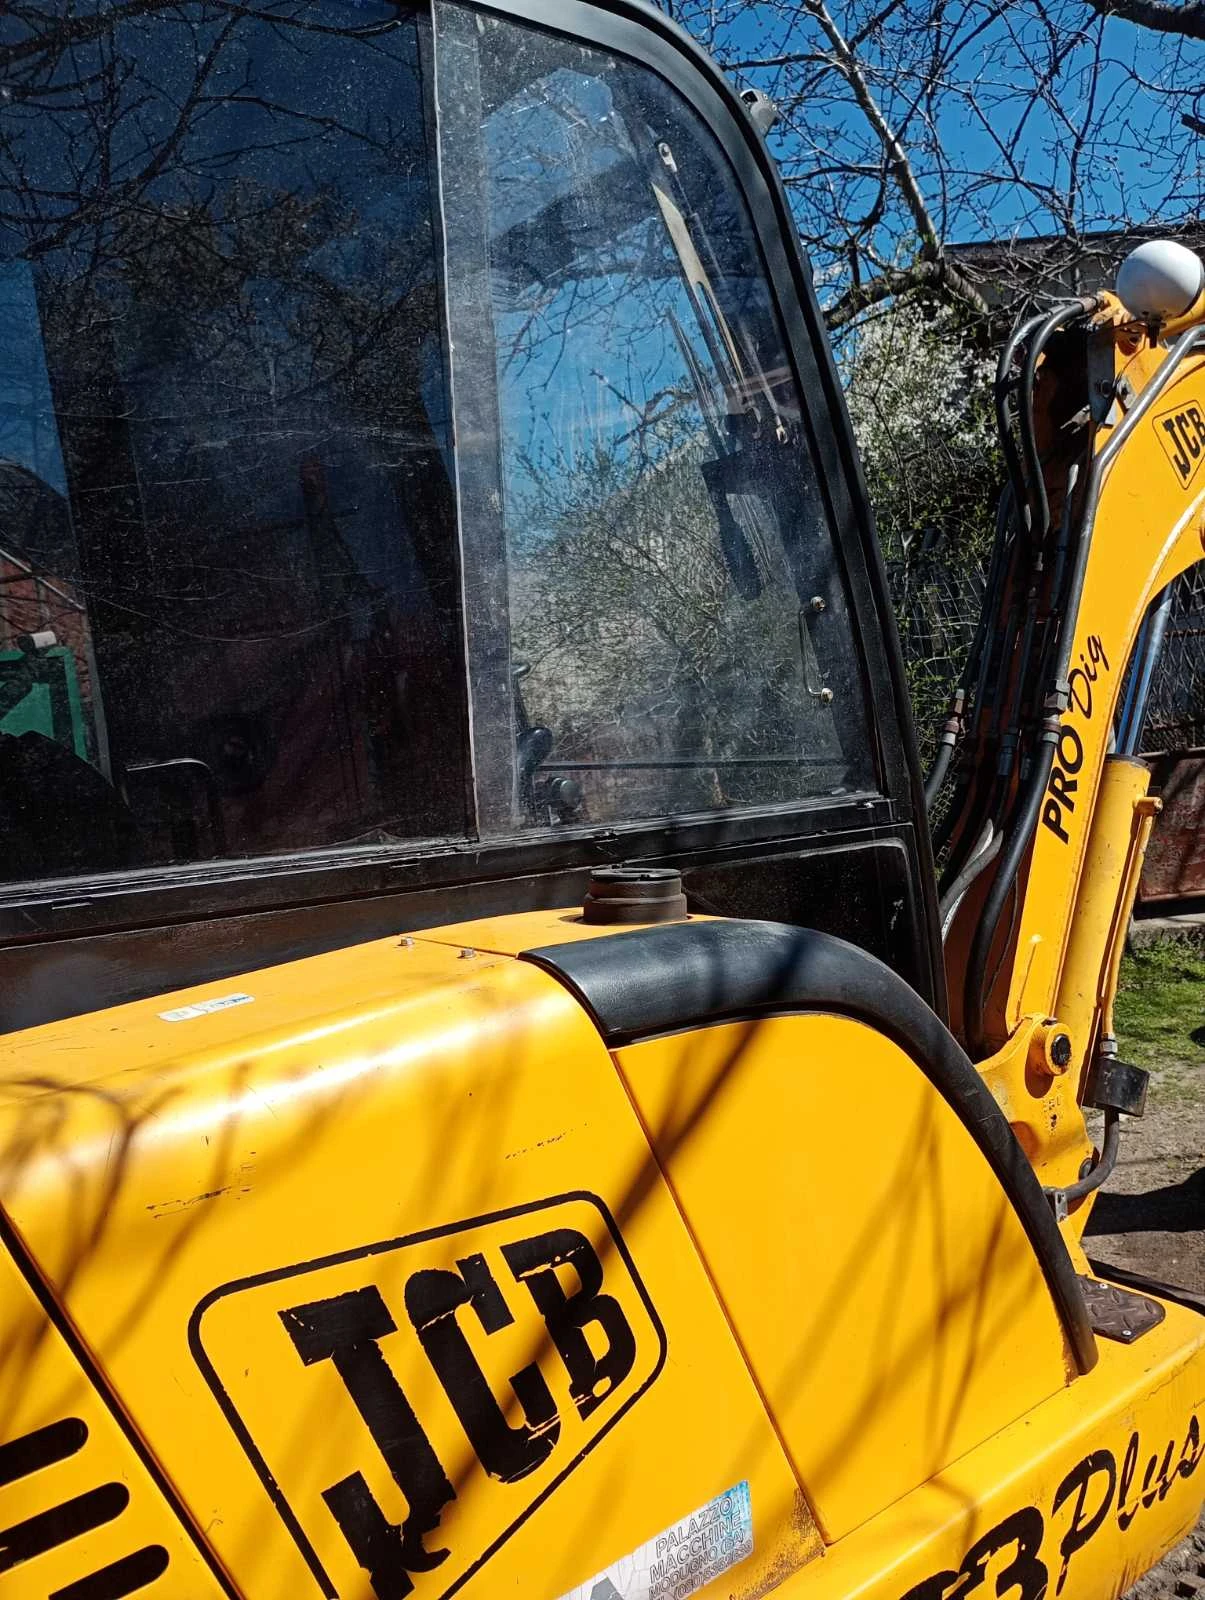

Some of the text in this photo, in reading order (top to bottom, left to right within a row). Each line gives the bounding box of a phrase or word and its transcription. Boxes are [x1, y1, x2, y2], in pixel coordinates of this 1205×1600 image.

[1163, 407, 1205, 480] JCB
[1042, 635, 1109, 845] PRO Dig
[277, 1228, 636, 1600] JCB
[656, 1496, 732, 1559] PALAZZO
[1051, 1414, 1205, 1597] Plus
[648, 1545, 718, 1600] MODUGNO
[649, 1510, 741, 1584] MACCHINE
